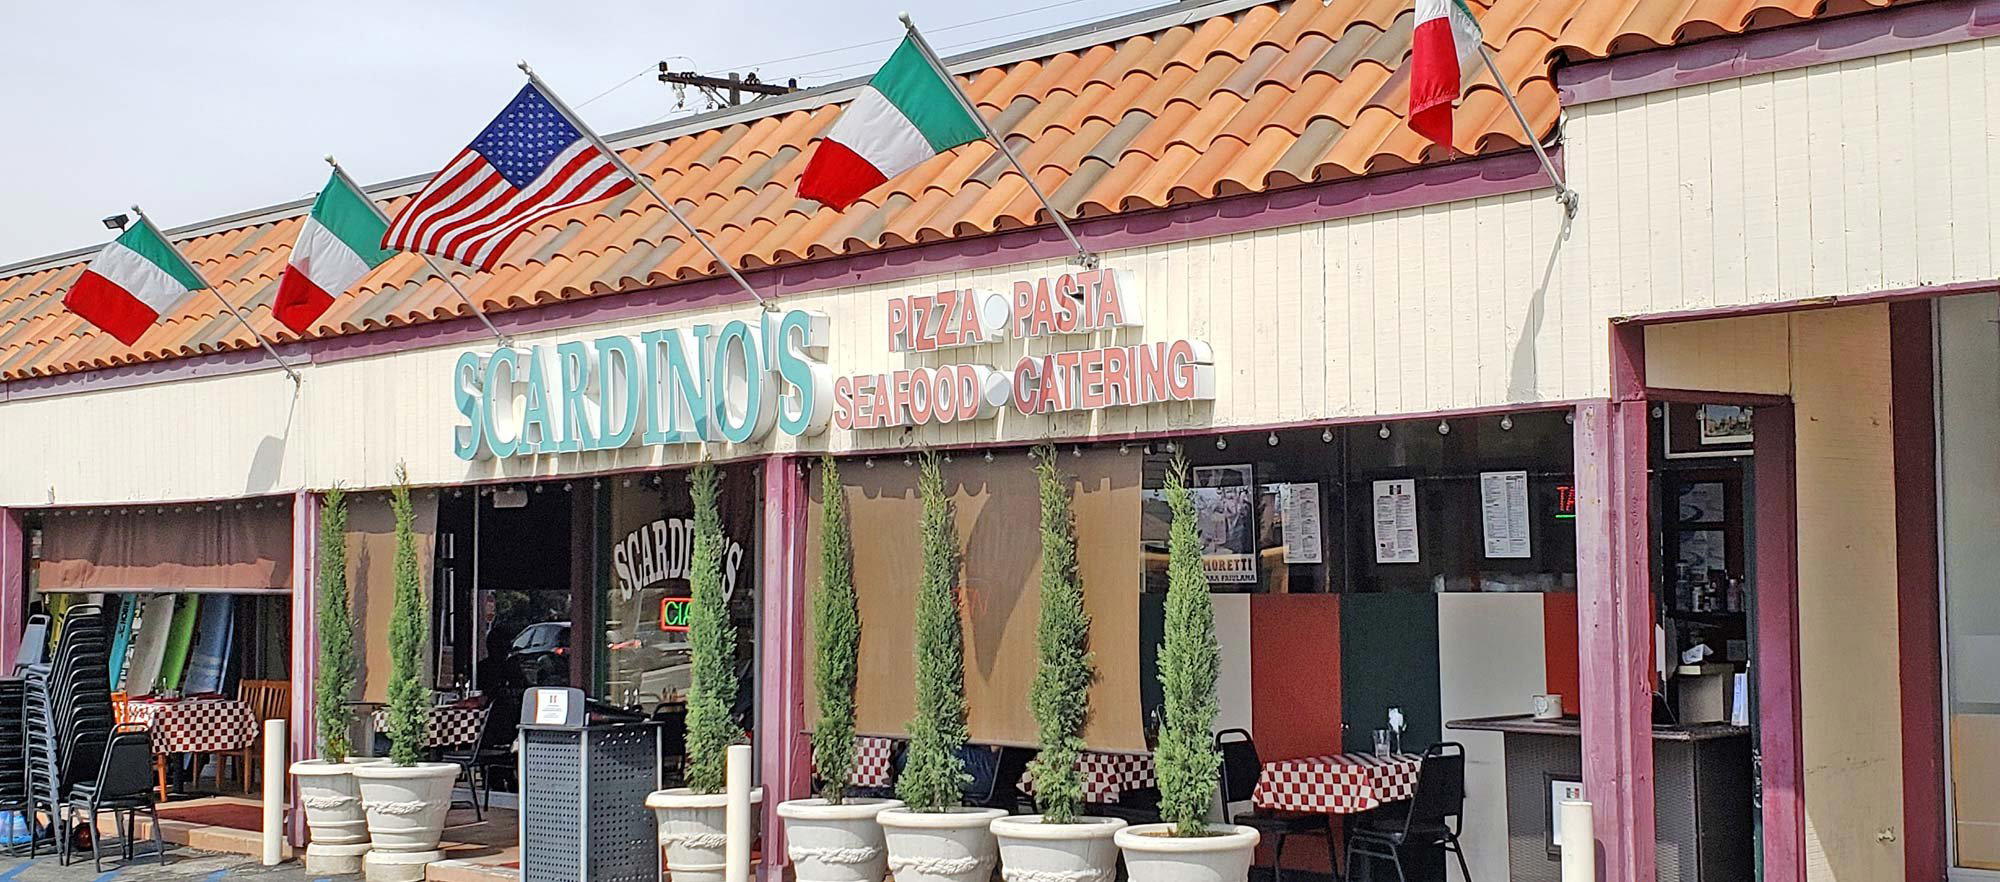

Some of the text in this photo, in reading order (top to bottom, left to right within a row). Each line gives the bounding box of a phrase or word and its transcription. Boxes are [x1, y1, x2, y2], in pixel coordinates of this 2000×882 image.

[888, 268, 1123, 353] PIZZA PASTA
[454, 309, 815, 461] SCARDINO'S
[834, 339, 1196, 431] SEAFOOD CATERING
[1556, 486, 1575, 511] TA
[614, 518, 744, 602] SCARDI'S
[1203, 558, 1252, 571] MORETTI
[664, 601, 691, 626] CIA
